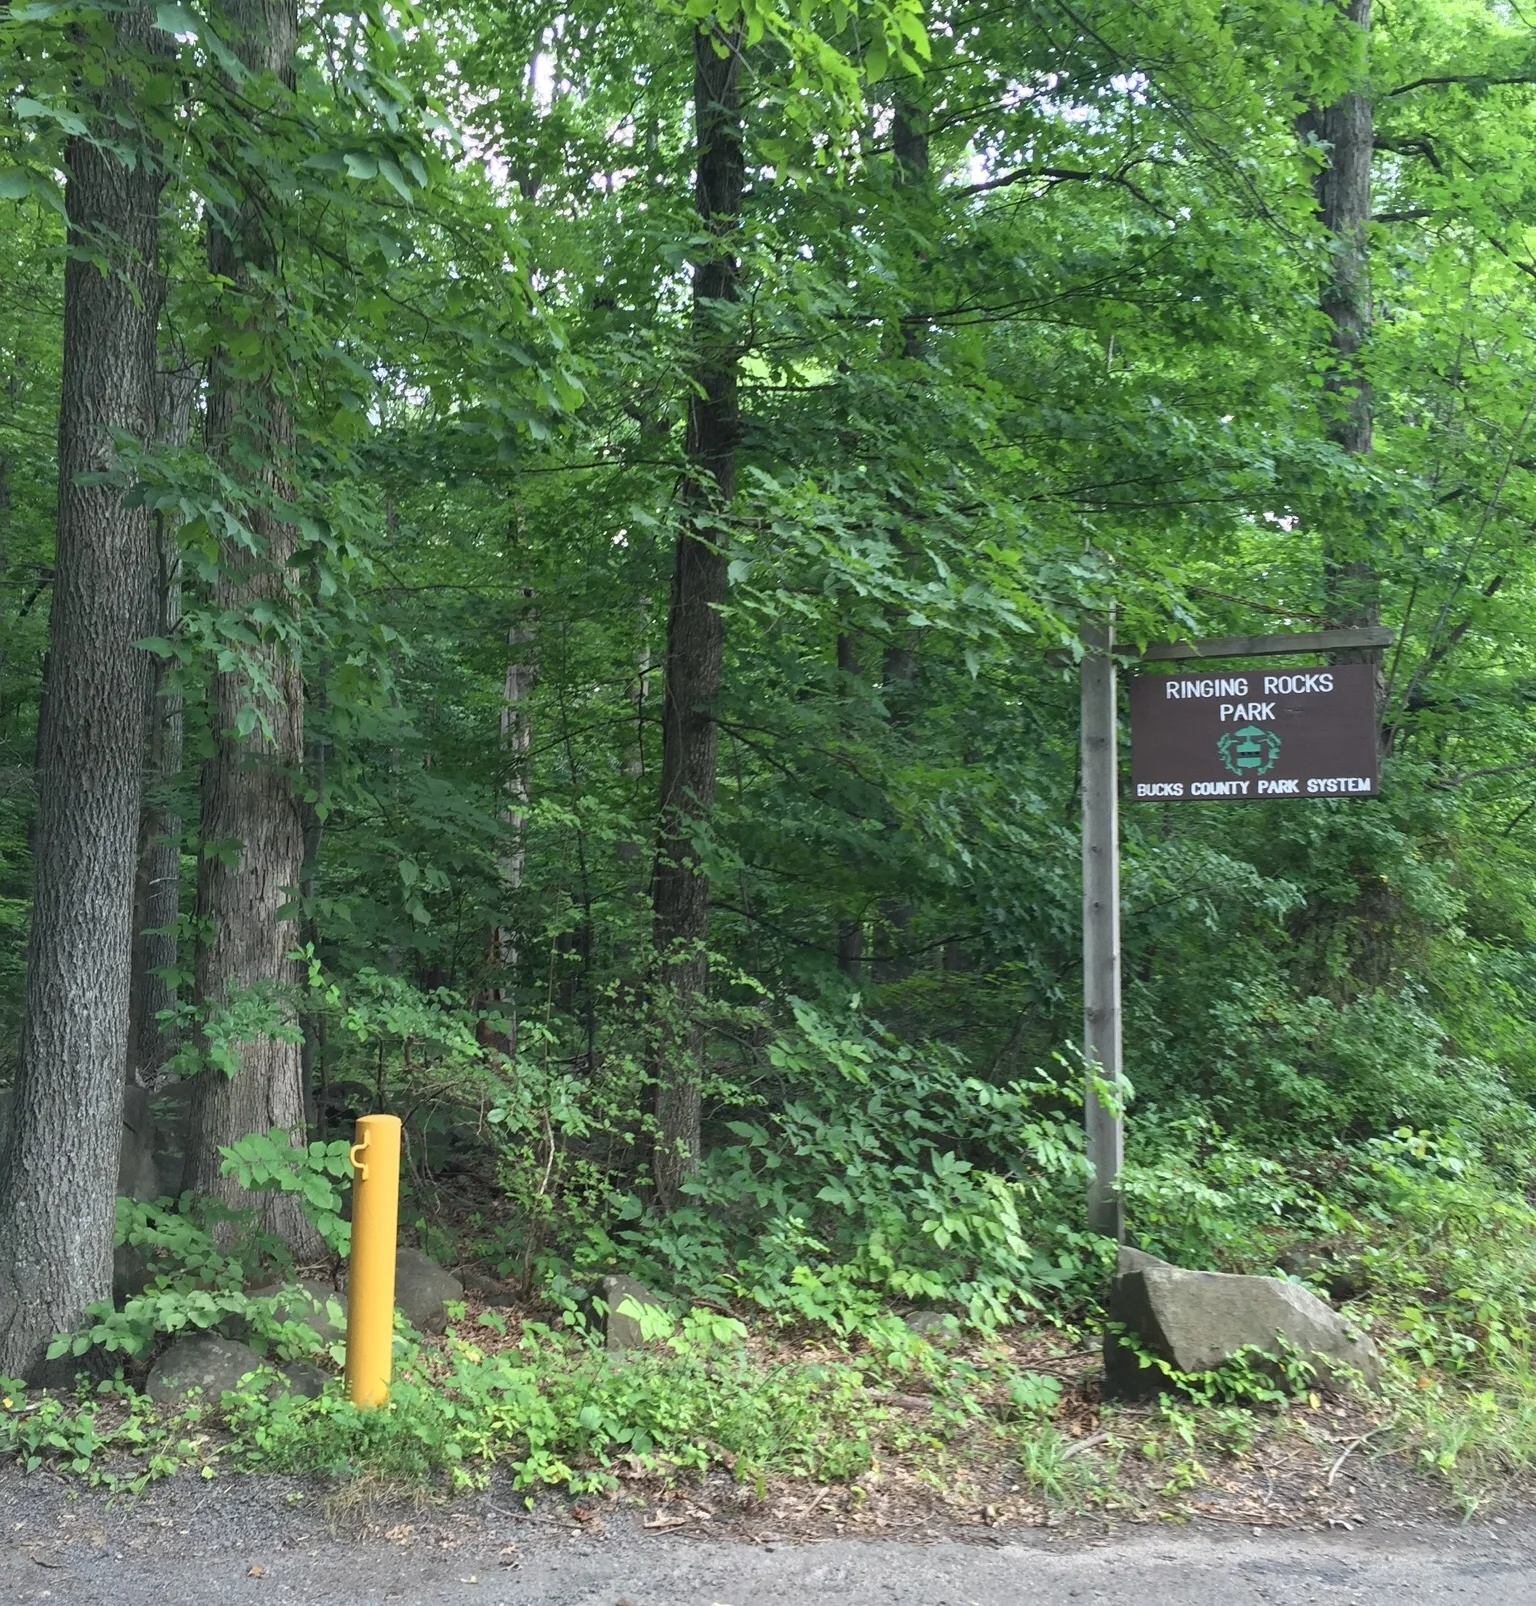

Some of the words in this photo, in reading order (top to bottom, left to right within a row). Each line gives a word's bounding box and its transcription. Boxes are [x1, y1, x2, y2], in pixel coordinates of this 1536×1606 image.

[1166, 677, 1249, 699] RINGING
[1264, 673, 1334, 695] ROCKS
[1219, 702, 1276, 721] PARK
[1137, 783, 1184, 797] BUCKS
[1190, 780, 1250, 796] COUNTY
[1257, 779, 1299, 794] PARK
[1306, 777, 1371, 793] SYSTEM
